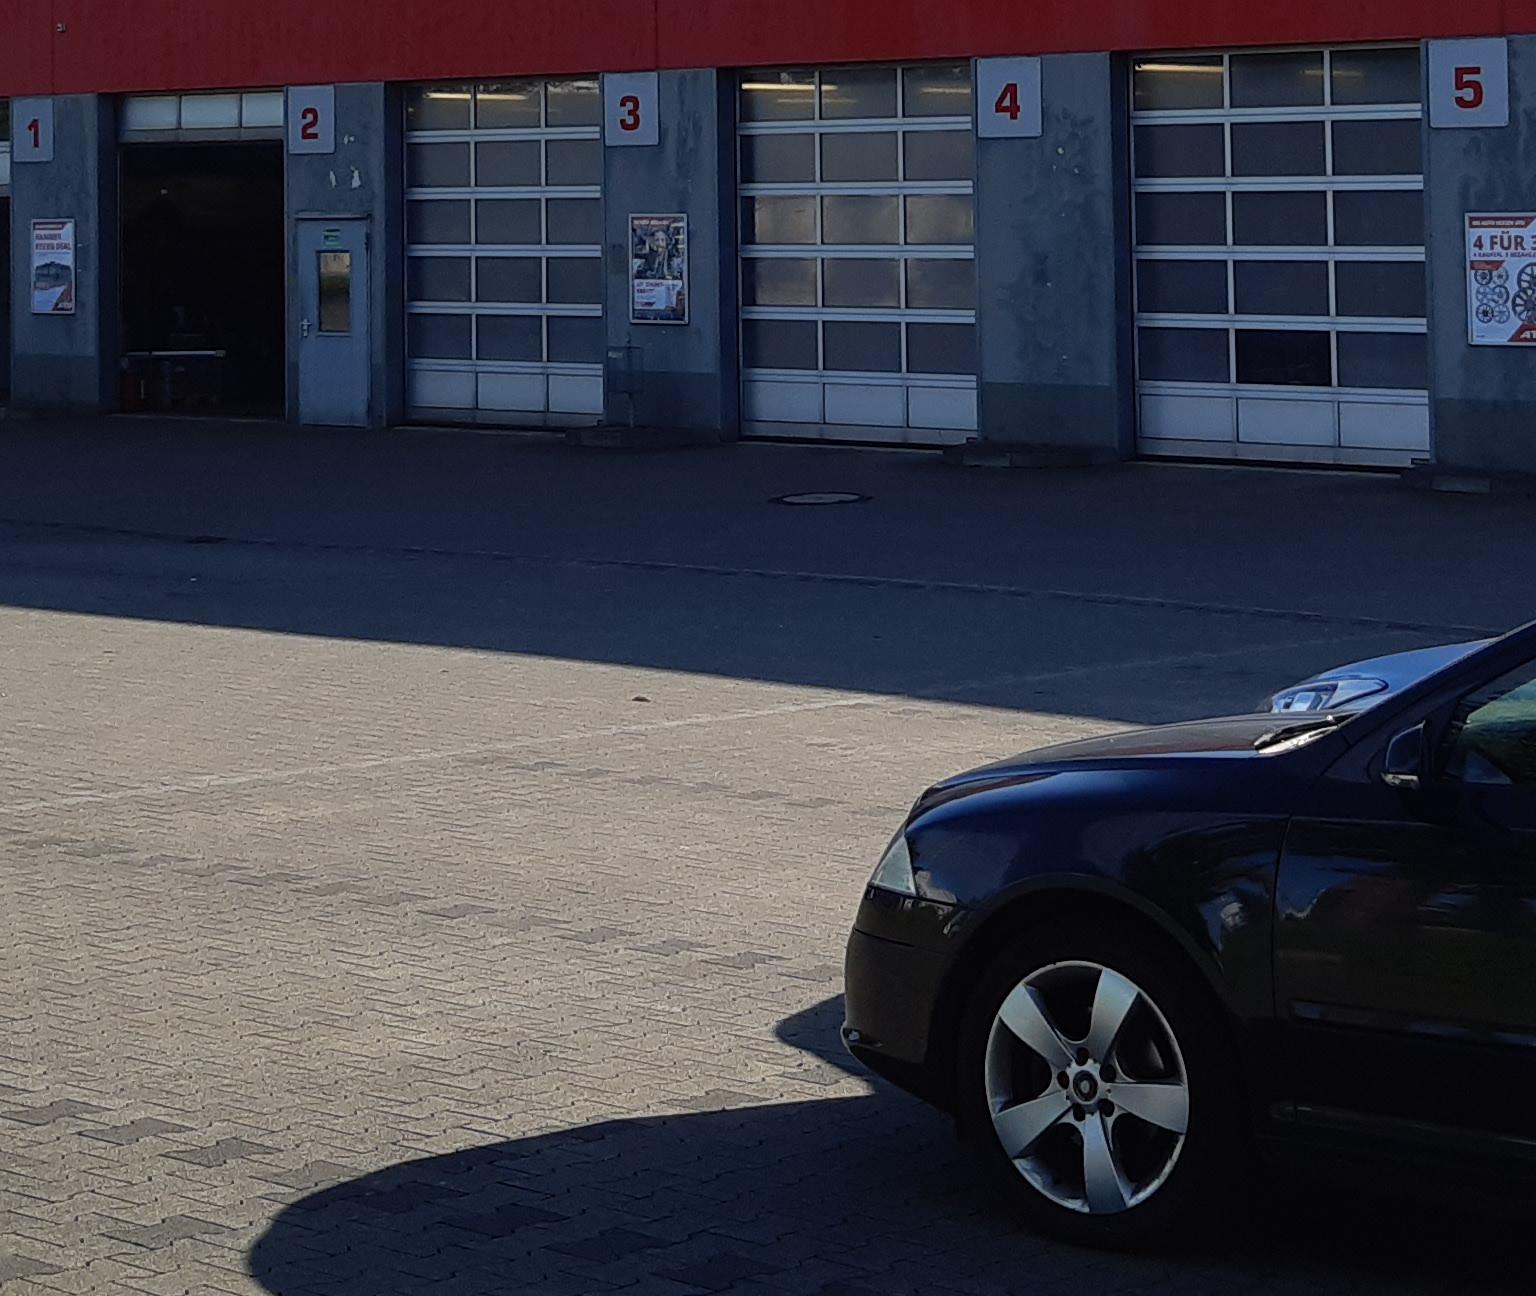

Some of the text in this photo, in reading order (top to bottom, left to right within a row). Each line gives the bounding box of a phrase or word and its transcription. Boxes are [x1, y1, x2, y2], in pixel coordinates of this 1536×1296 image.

[994, 83, 1020, 120] 4
[1454, 66, 1484, 109] 5
[301, 107, 319, 140] 2
[619, 95, 641, 131] 3
[27, 118, 40, 148] 1
[1473, 235, 1484, 250] 4
[1489, 230, 1526, 250] FÜR
